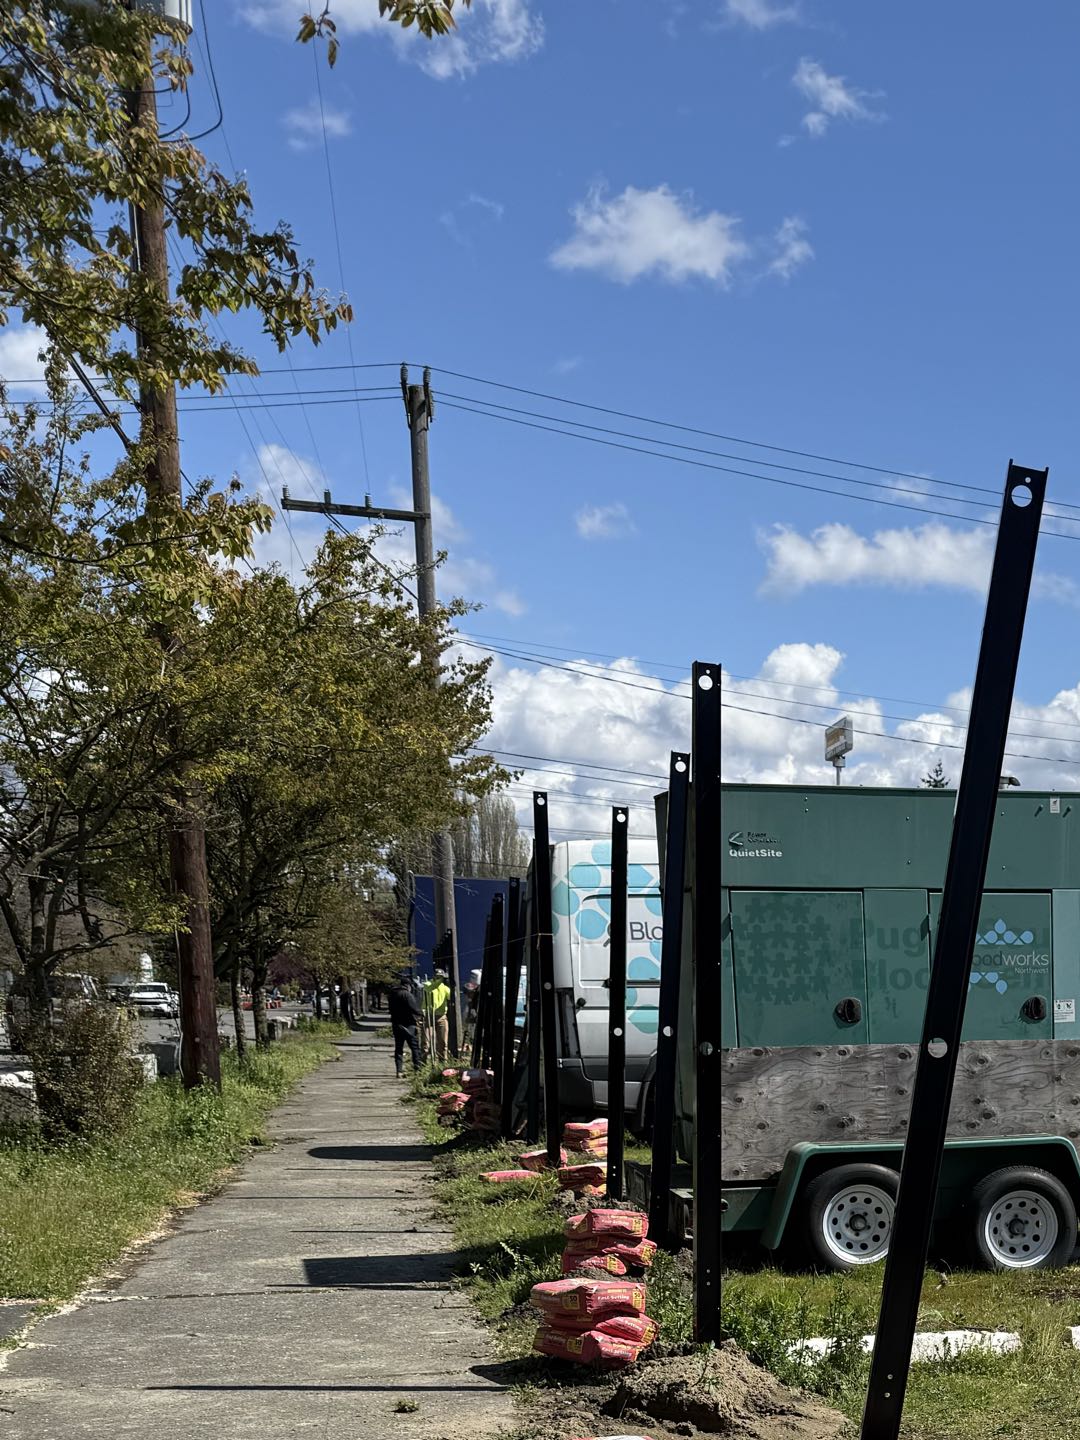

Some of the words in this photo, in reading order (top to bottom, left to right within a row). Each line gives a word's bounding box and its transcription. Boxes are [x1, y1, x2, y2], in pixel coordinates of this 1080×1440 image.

[729, 849, 783, 858] QuietSite
[629, 921, 664, 941] Blo
[972, 950, 1049, 966] oodworks
[1015, 967, 1049, 975] Northwest
